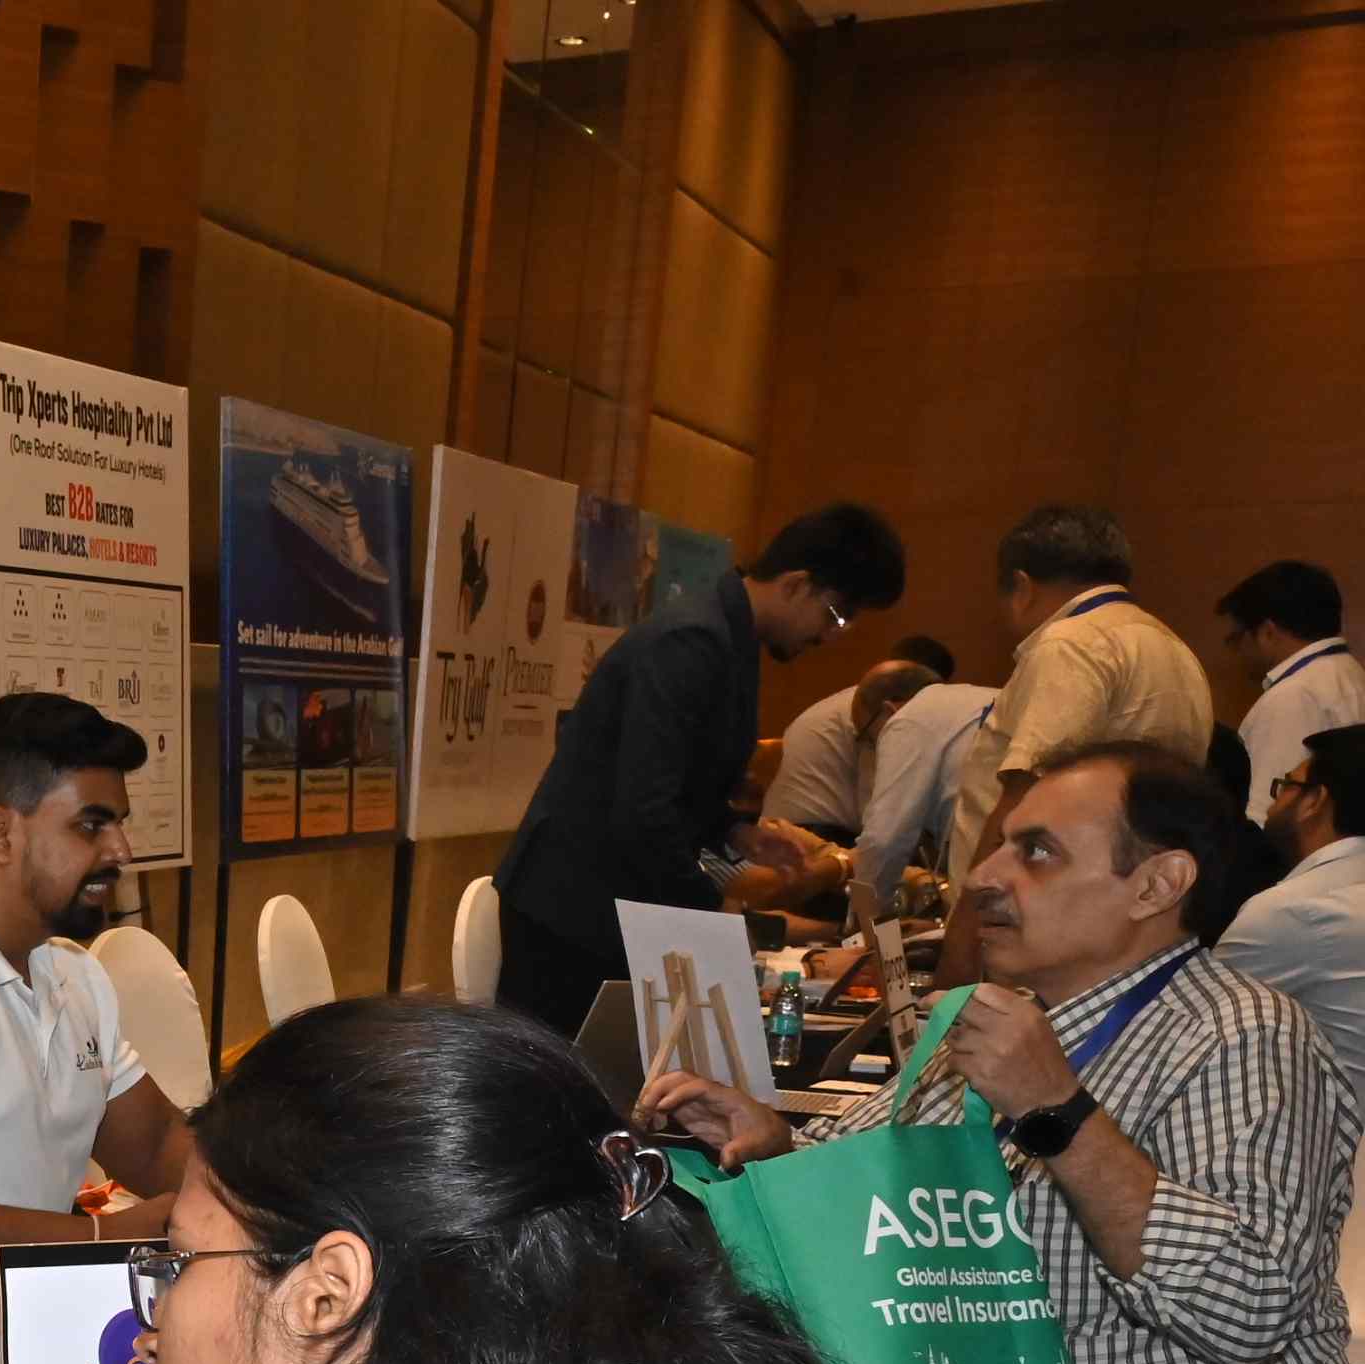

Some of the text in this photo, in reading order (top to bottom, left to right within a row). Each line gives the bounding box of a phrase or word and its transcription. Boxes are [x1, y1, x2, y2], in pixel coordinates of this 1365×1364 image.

[27, 380, 69, 430] Xperts
[71, 390, 133, 447] Hospitality
[136, 407, 155, 442] Pvt
[156, 411, 173, 449] Ltd
[34, 440, 56, 460] Roof
[56, 443, 94, 468] Solution
[94, 451, 109, 469] For
[109, 457, 137, 481] Luxury
[45, 482, 134, 529] BEST B2B RATES FOR
[19, 526, 51, 553] LUXURY
[238, 620, 254, 645] Set
[895, 1266, 1033, 1287] Global Assistance
[871, 1296, 954, 1327] Travel
